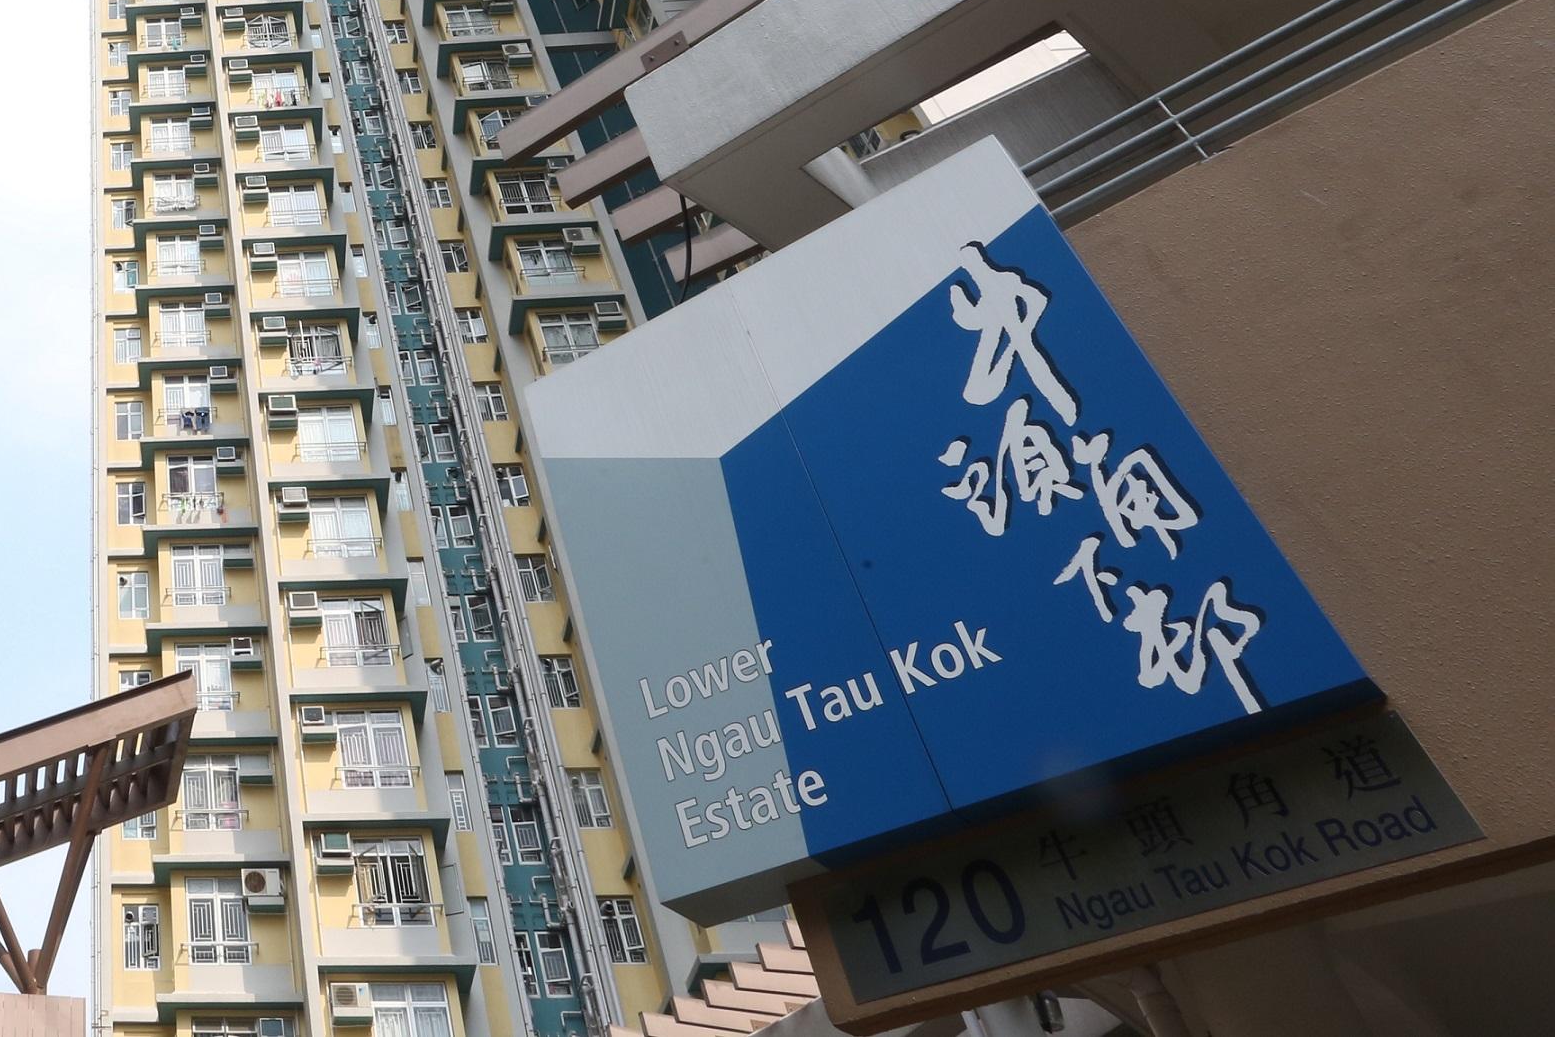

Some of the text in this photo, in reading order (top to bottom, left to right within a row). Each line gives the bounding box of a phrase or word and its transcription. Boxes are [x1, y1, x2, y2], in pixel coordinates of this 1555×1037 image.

[639, 638, 774, 719] Lower
[655, 619, 1004, 783] Ngau Tau Kok
[675, 768, 828, 849] Estate
[1036, 735, 1402, 881] 牛頭角道
[1055, 795, 1439, 931] Ngau Tau Kok Road
[851, 858, 1026, 975] 120
